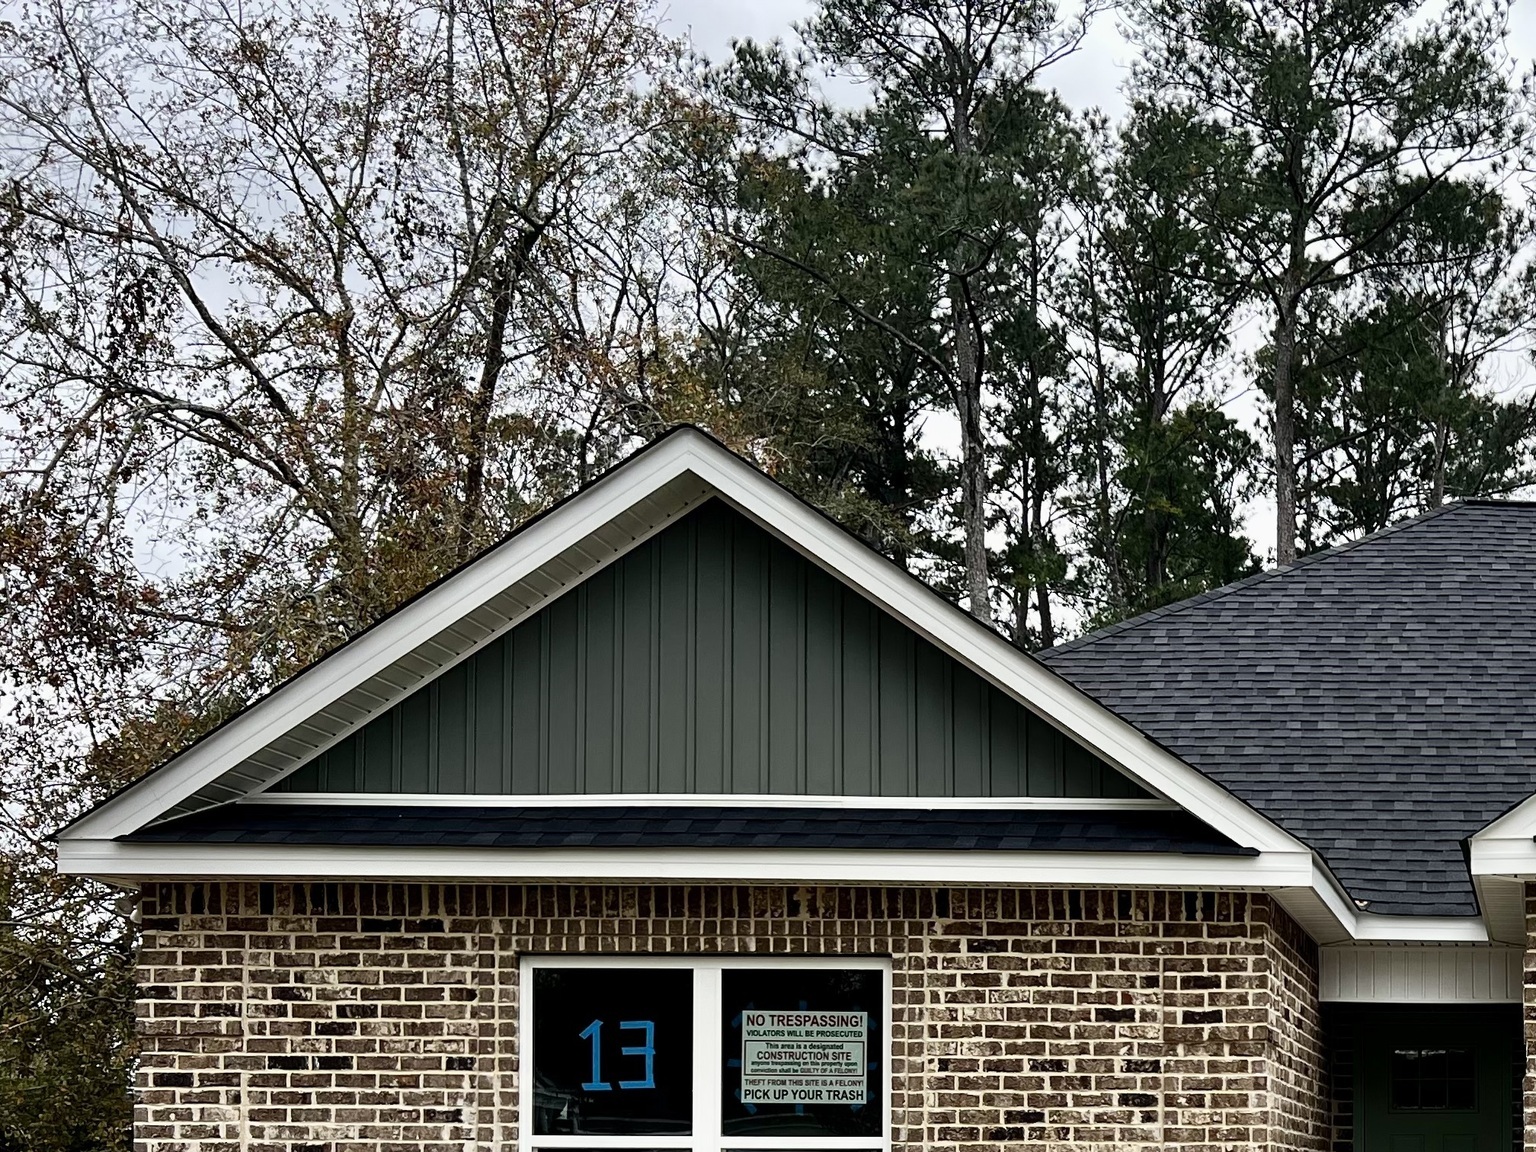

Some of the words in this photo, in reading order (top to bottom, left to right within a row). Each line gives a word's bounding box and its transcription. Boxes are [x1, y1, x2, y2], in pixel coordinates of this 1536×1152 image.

[747, 1015, 765, 1026] NO
[769, 1015, 862, 1027] TRESPASSING!
[579, 1019, 656, 1091] 13
[757, 1052, 829, 1060] CONSTRUCTION
[832, 1052, 851, 1060] SITE
[744, 1089, 770, 1099] PICK
[774, 1090, 788, 1100] UP
[791, 1090, 822, 1100] YOUR
[826, 1090, 863, 1100] TRASH
